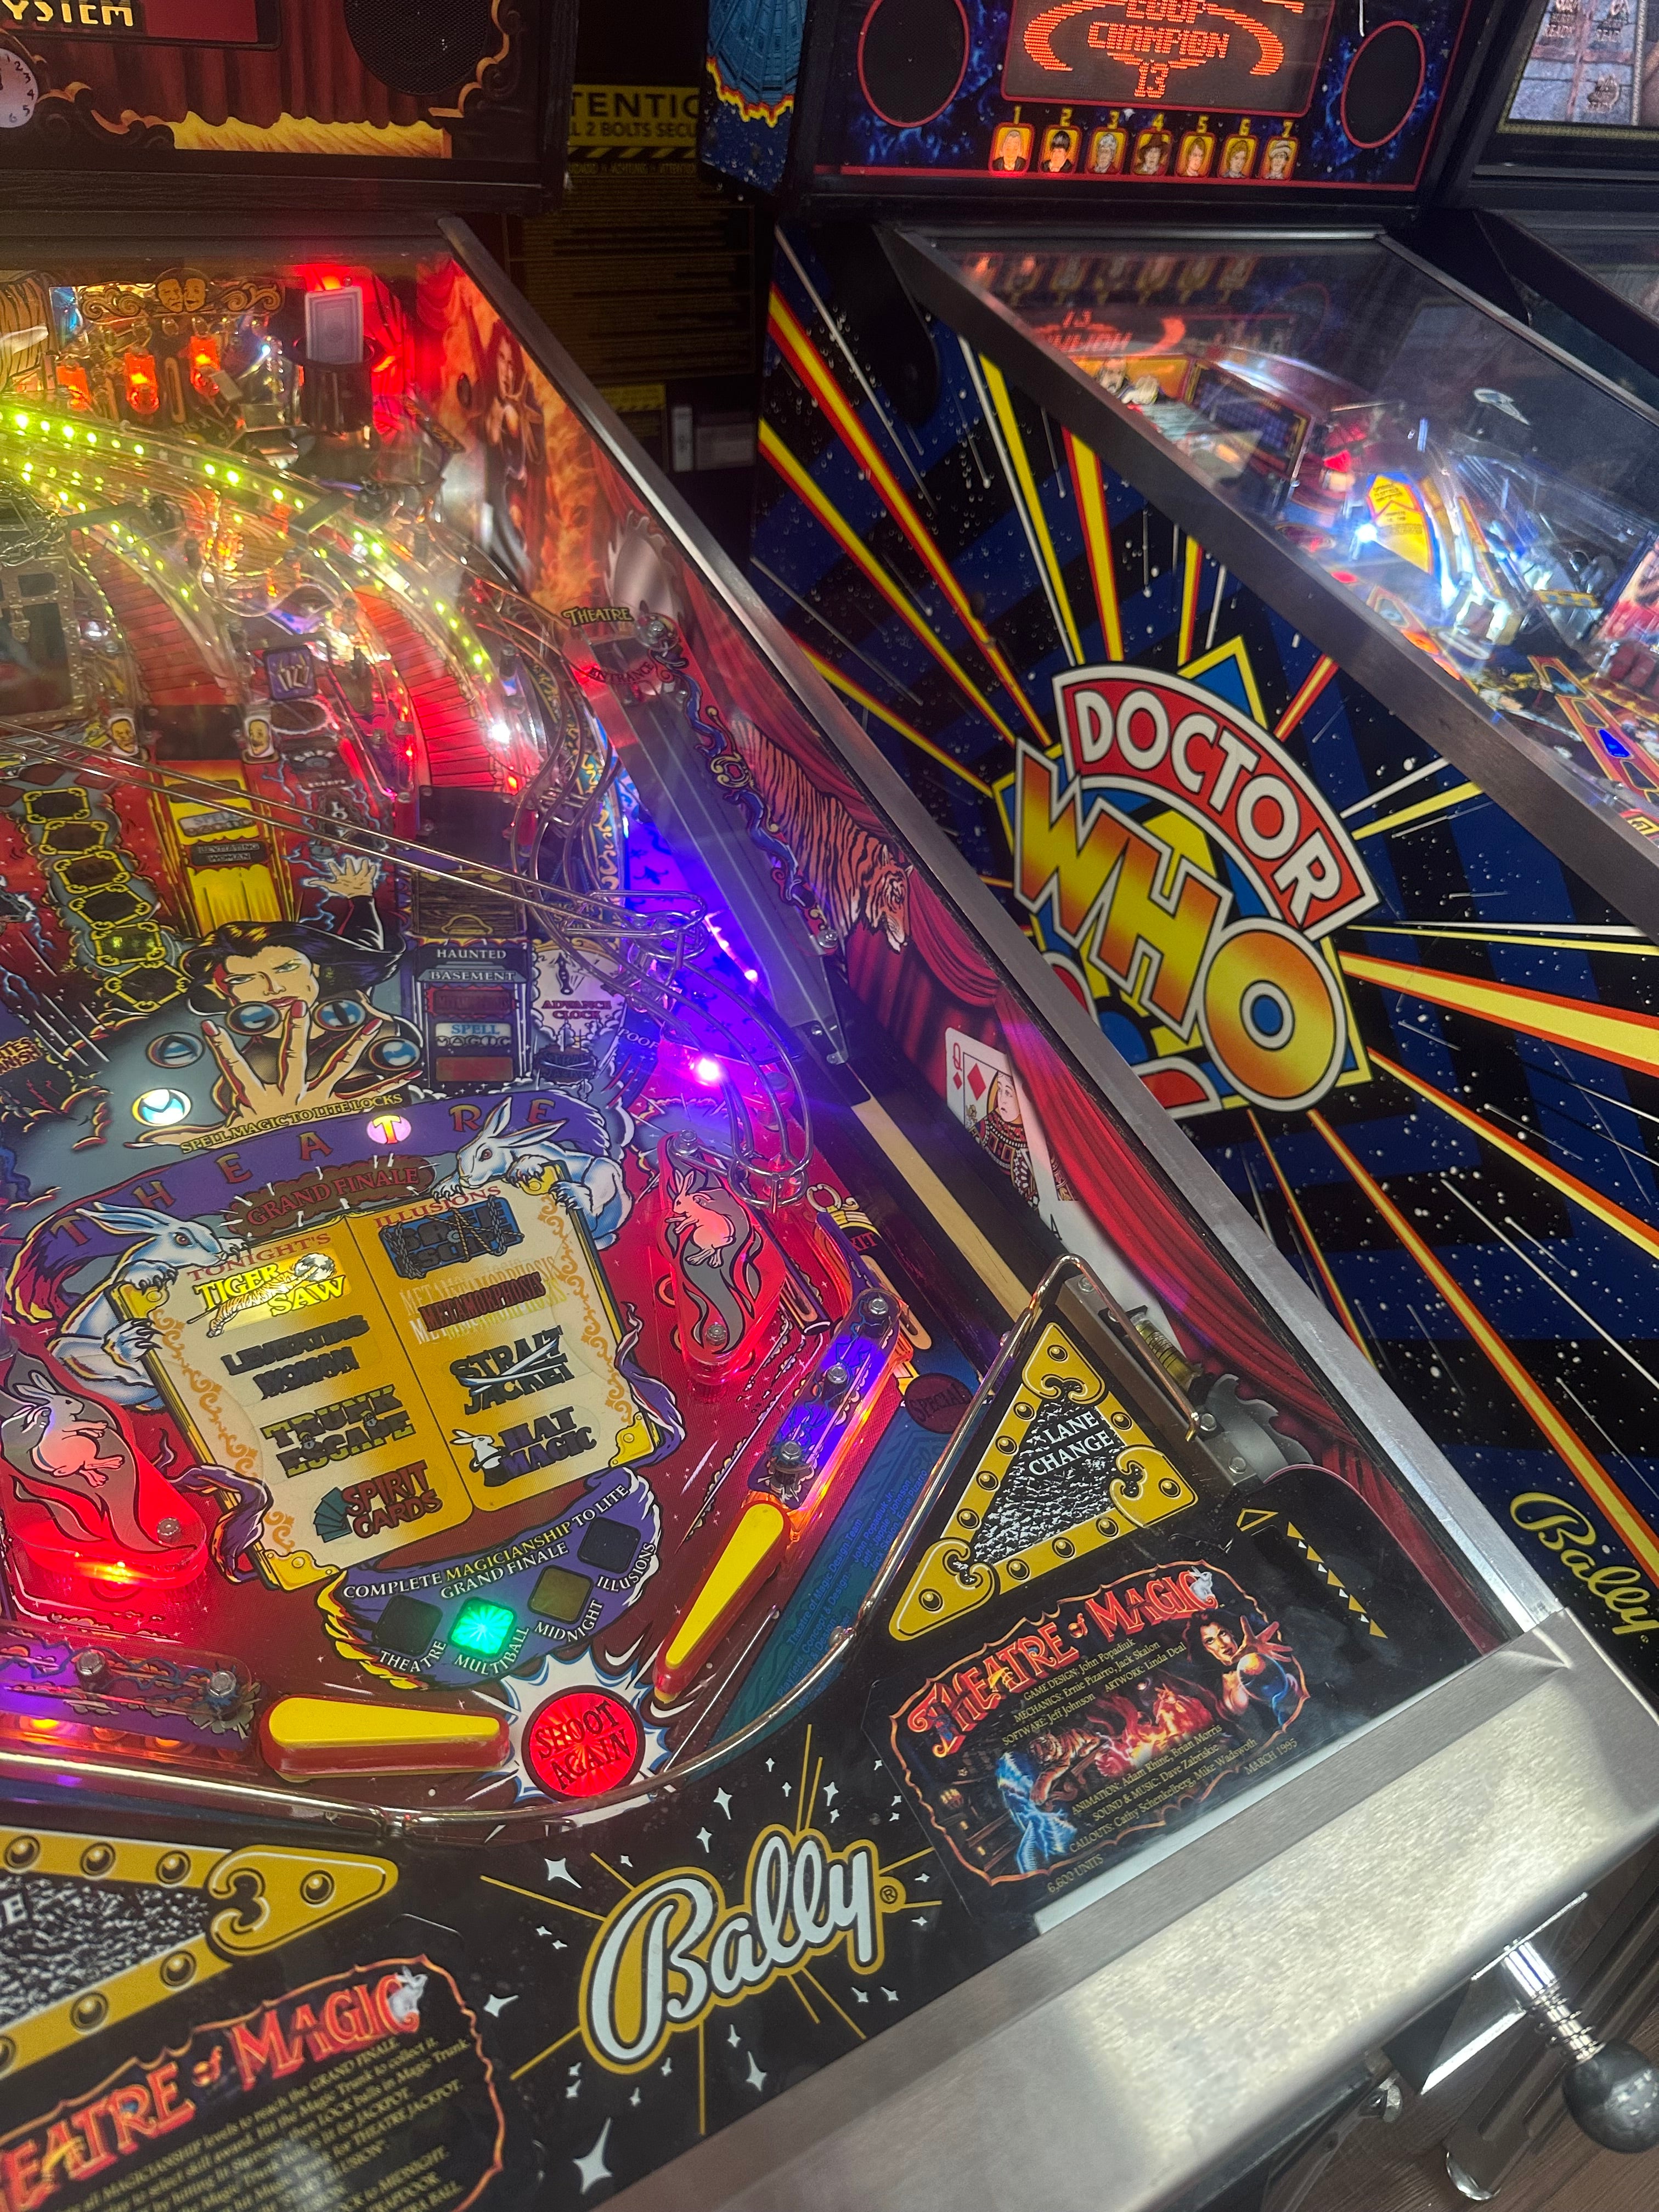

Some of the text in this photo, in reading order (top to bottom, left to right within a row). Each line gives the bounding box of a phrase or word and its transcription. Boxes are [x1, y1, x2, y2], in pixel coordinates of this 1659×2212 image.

[1088, 21, 1229, 58] CHAMPION
[1134, 61, 1169, 98] 13
[1013, 105, 1294, 139] 1 2 3 4 5 6 7
[561, 607, 634, 626] THEATRE
[1070, 687, 1342, 921] DOCTOR
[199, 843, 260, 854] LEVITATING
[207, 853, 251, 862] WOMAN
[1014, 737, 1348, 1113] WHO
[430, 971, 515, 980] BASEMENT
[437, 949, 507, 959] HAUNTED
[451, 1024, 500, 1035] SPELL
[541, 1001, 611, 1010] ADVANCE
[552, 1011, 601, 1020] CLOCK
[618, 1028, 658, 1049] POOF
[952, 1042, 962, 1071] Q
[180, 1093, 403, 1153] SPELL MAGIC TO LITE LOCKS
[247, 1166, 420, 1226] GRAND FINALE
[373, 1186, 501, 1228] ILLUSIONS
[187, 1233, 331, 1282] TONIGHT'S
[850, 1232, 878, 1252] XIT
[191, 1263, 279, 1312] TIGER
[267, 1274, 346, 1317] SAW
[417, 1271, 546, 1332] METAMORPHOSIS
[449, 1324, 563, 1384] STRAIT
[464, 1353, 575, 1415] JACKET
[909, 1381, 962, 1423] SPECIAL
[259, 1383, 404, 1449] TRUNK
[498, 1406, 577, 1452] HAT
[1042, 1409, 1101, 1447] LANE
[275, 1410, 416, 1479] ESCAPE
[498, 1426, 597, 1478] MAGIC
[1028, 1429, 1114, 1478] CHANGE
[341, 1459, 430, 1516] SPIRIT
[352, 1488, 443, 1539] CARDS
[858, 1548, 874, 1567] Jeff
[887, 1480, 913, 1514] Johnson
[867, 1549, 885, 1571] Jack
[895, 1497, 913, 1519] Ernie
[910, 1470, 928, 1499] Pizarro
[342, 1485, 630, 1599] COMPLETE MAGICIANSHIP TO LITE
[596, 1541, 656, 1593] ILLUSIONS
[1509, 1492, 1659, 1636] Bally
[440, 1541, 569, 1600] GRAND FINALE
[787, 1518, 864, 1645] Theatre of Magic Design Team
[800, 1615, 828, 1652] Concept
[827, 1571, 851, 1605] Design:
[849, 1539, 869, 1562] John
[861, 1502, 890, 1539] Popadiuk
[534, 1599, 604, 1643] MIDNIGHT
[378, 1639, 447, 1673] THEATRE
[453, 1626, 530, 1675] MULTIBALL
[907, 1620, 1080, 1759] THEATRE
[1085, 1568, 1217, 1643] MAGIC
[1024, 1638, 1136, 1702] GAME DESIGN: John Popadiuk
[1002, 1642, 1187, 1746] SOFTWARE: Jeff Johnson ARTWORK: Linda Deal
[1013, 1641, 1160, 1723] MECHANICS: Ernie Pizarro, Jack Skalon
[534, 1700, 620, 1760] SHOOT
[550, 1729, 634, 1791] AGAIN
[1072, 1724, 1223, 1816] ANIMATION: Adam Rhine, Brian Morris
[1092, 1744, 1219, 1822] SOUND & MUSIC: Dave Zabriskie
[1243, 1738, 1298, 1777] MARCH 1995
[1069, 1822, 1115, 1853] CALLOUTS:
[1114, 1807, 1139, 1828] Cathy
[1139, 1778, 1195, 1813] Schenkelberg,
[1195, 1764, 1216, 1782] Mike
[1047, 1853, 1104, 1894] 6,600 UNITS
[585, 1829, 878, 2068] Bally
[286, 2083, 311, 2103] the
[307, 2057, 357, 2092] GRAND
[385, 2040, 426, 2070] collect
[0, 2061, 197, 2212] EATRE
[228, 1973, 420, 2091] MAGIC
[315, 2097, 355, 2127] LOCK
